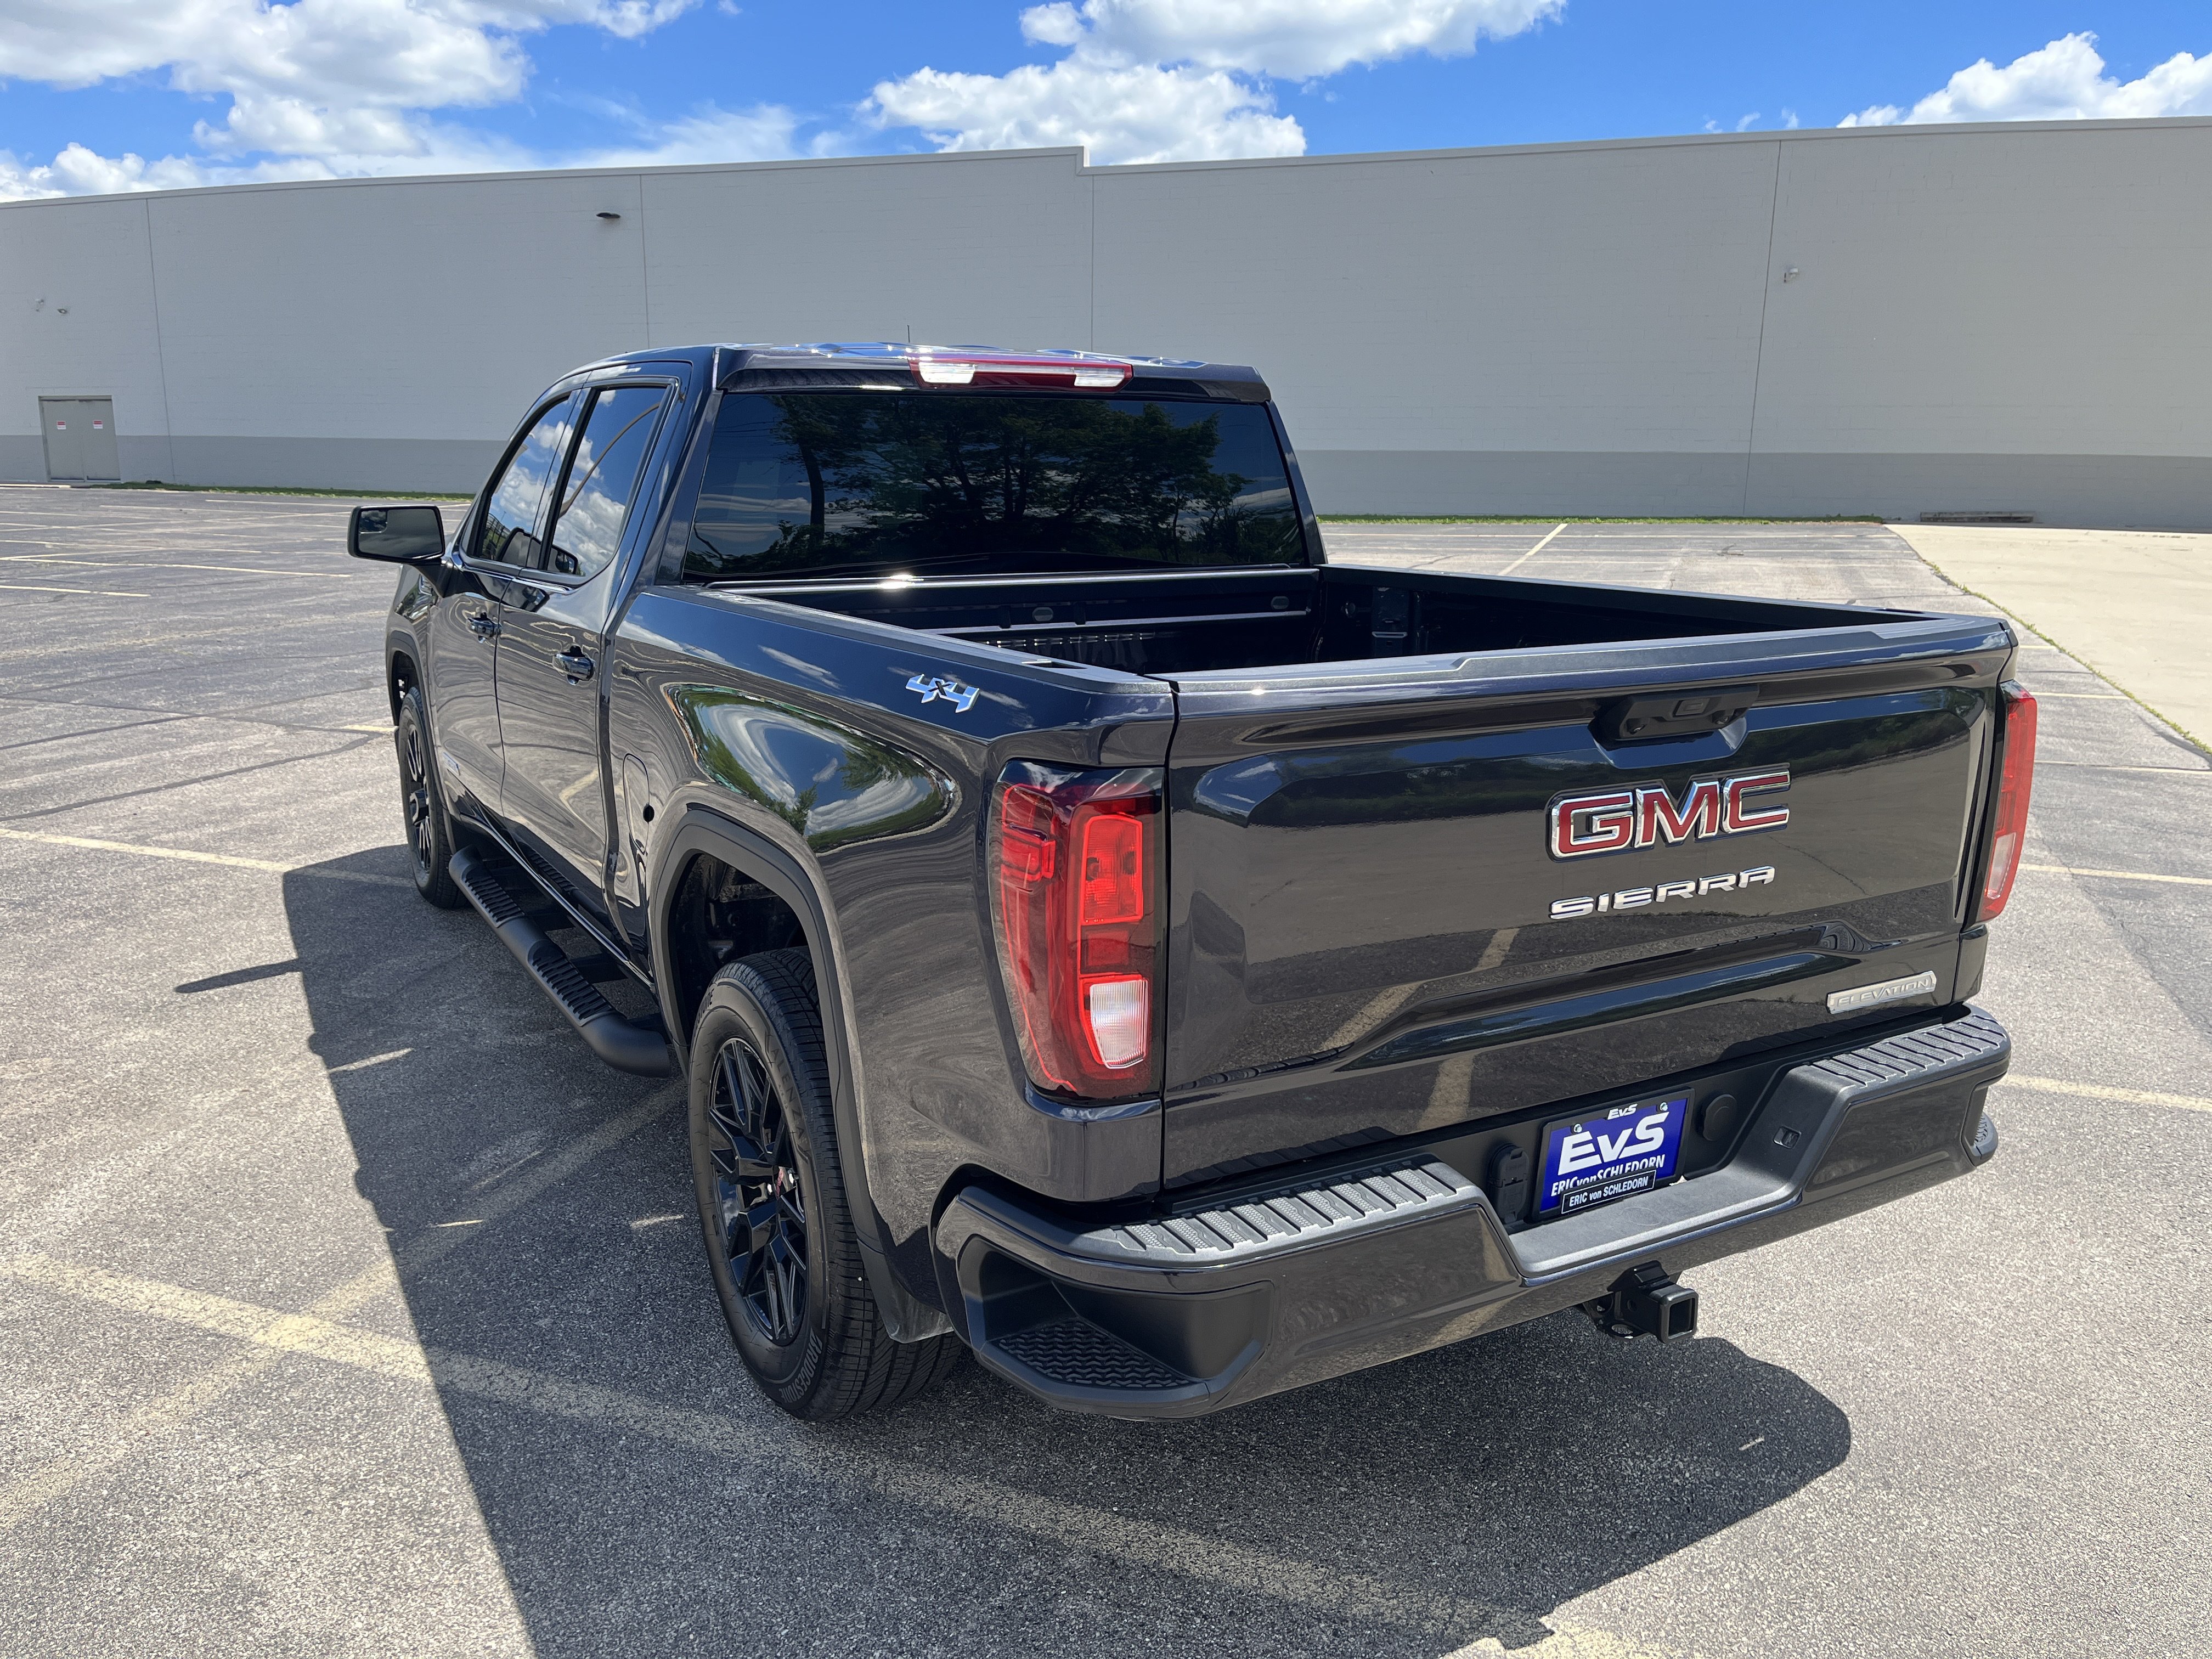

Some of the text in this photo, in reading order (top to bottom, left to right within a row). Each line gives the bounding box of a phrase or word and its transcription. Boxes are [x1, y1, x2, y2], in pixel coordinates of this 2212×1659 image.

[1549, 768, 1791, 859] GMC
[1550, 866, 1775, 919] SIERRA
[1837, 978, 1929, 1006] ELEVATION
[771, 1048, 805, 1139] ALENZA
[1569, 1176, 1649, 1207] ERIC von SCHLEDORN
[778, 1326, 823, 1403] BRIDGESTONE
